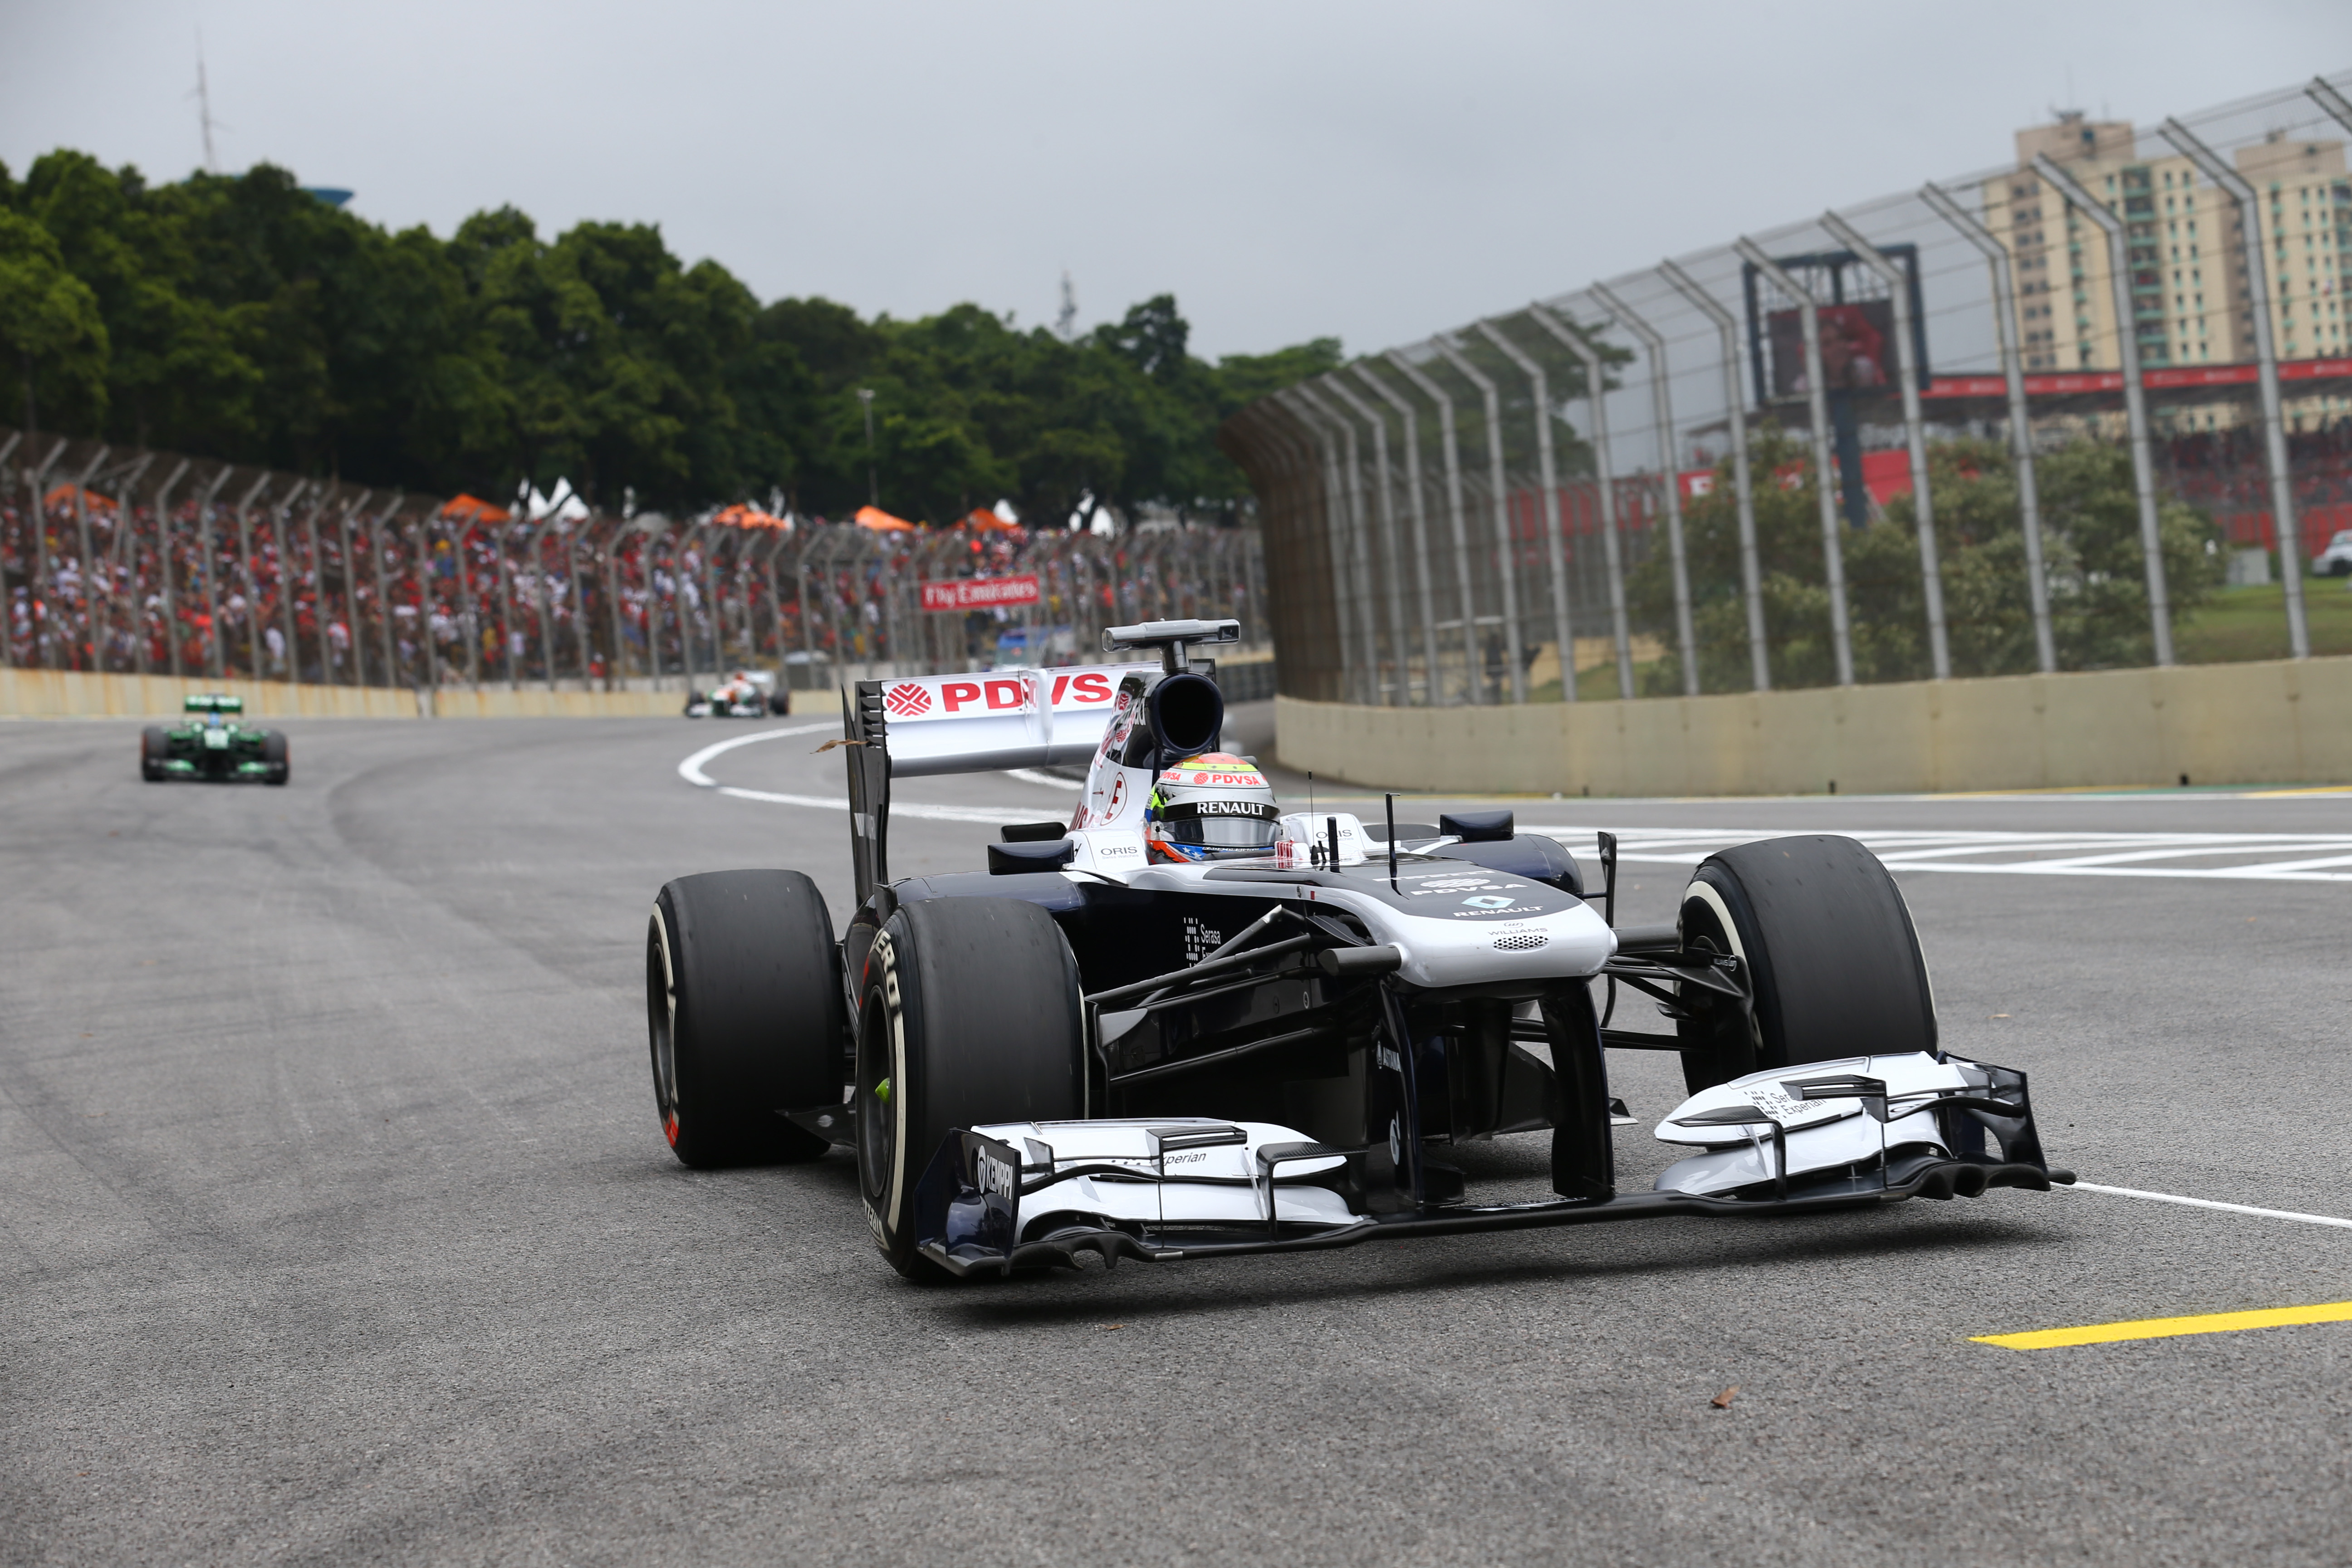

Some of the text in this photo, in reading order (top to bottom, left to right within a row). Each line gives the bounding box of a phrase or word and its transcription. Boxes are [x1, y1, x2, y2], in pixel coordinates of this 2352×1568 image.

[941, 673, 1113, 712] PDVS
[1211, 774, 1261, 785] PDVSA
[1196, 802, 1265, 816] RENAULT
[1316, 829, 1352, 839] OIS
[1101, 846, 1137, 856] ORIS
[1410, 883, 1529, 896] PDVSA
[1453, 906, 1544, 917] RENAULT
[1200, 923, 1221, 945] Serasa
[1488, 927, 1548, 936] WILLIAMS
[986, 1154, 1013, 1200] KEMPPI
